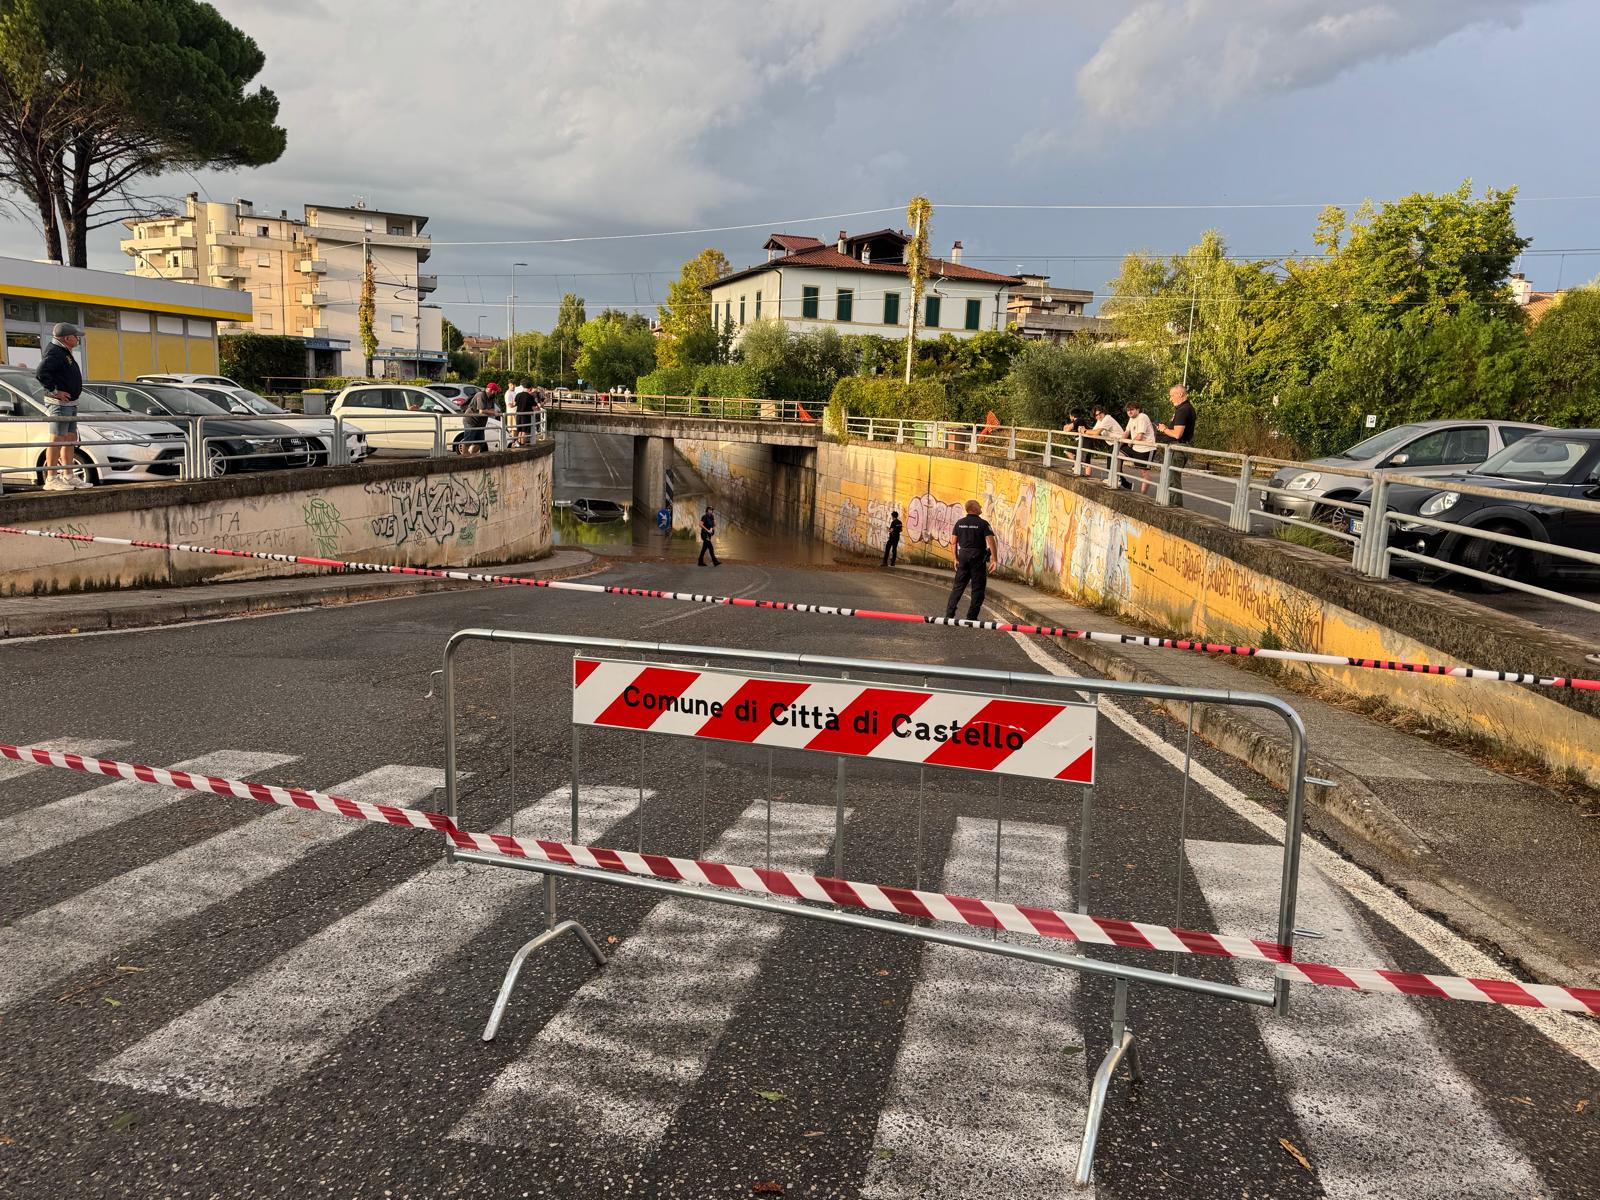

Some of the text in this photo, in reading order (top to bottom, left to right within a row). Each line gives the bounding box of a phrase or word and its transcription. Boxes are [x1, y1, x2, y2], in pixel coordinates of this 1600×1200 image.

[623, 685, 1024, 751] Comune di Città di Castello
